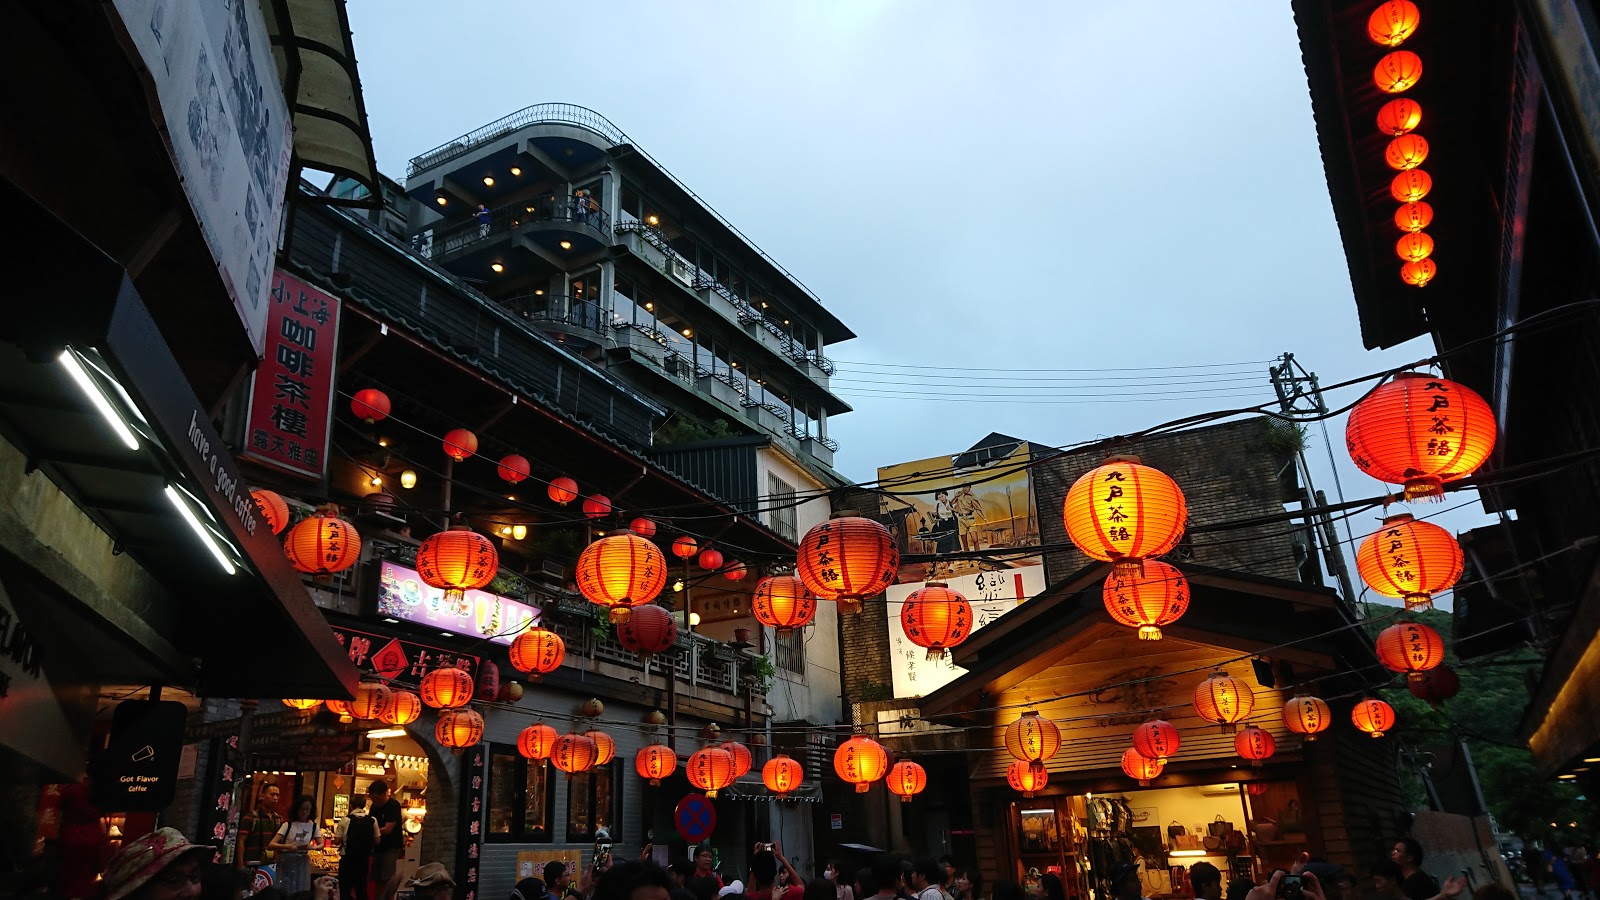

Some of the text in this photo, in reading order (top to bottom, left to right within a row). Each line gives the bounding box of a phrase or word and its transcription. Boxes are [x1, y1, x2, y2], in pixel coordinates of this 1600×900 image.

[271, 280, 332, 326] 小上海
[271, 315, 317, 439] 咖啡茶樓
[188, 409, 256, 537] have a good coffee
[120, 775, 159, 783] Got Flavor
